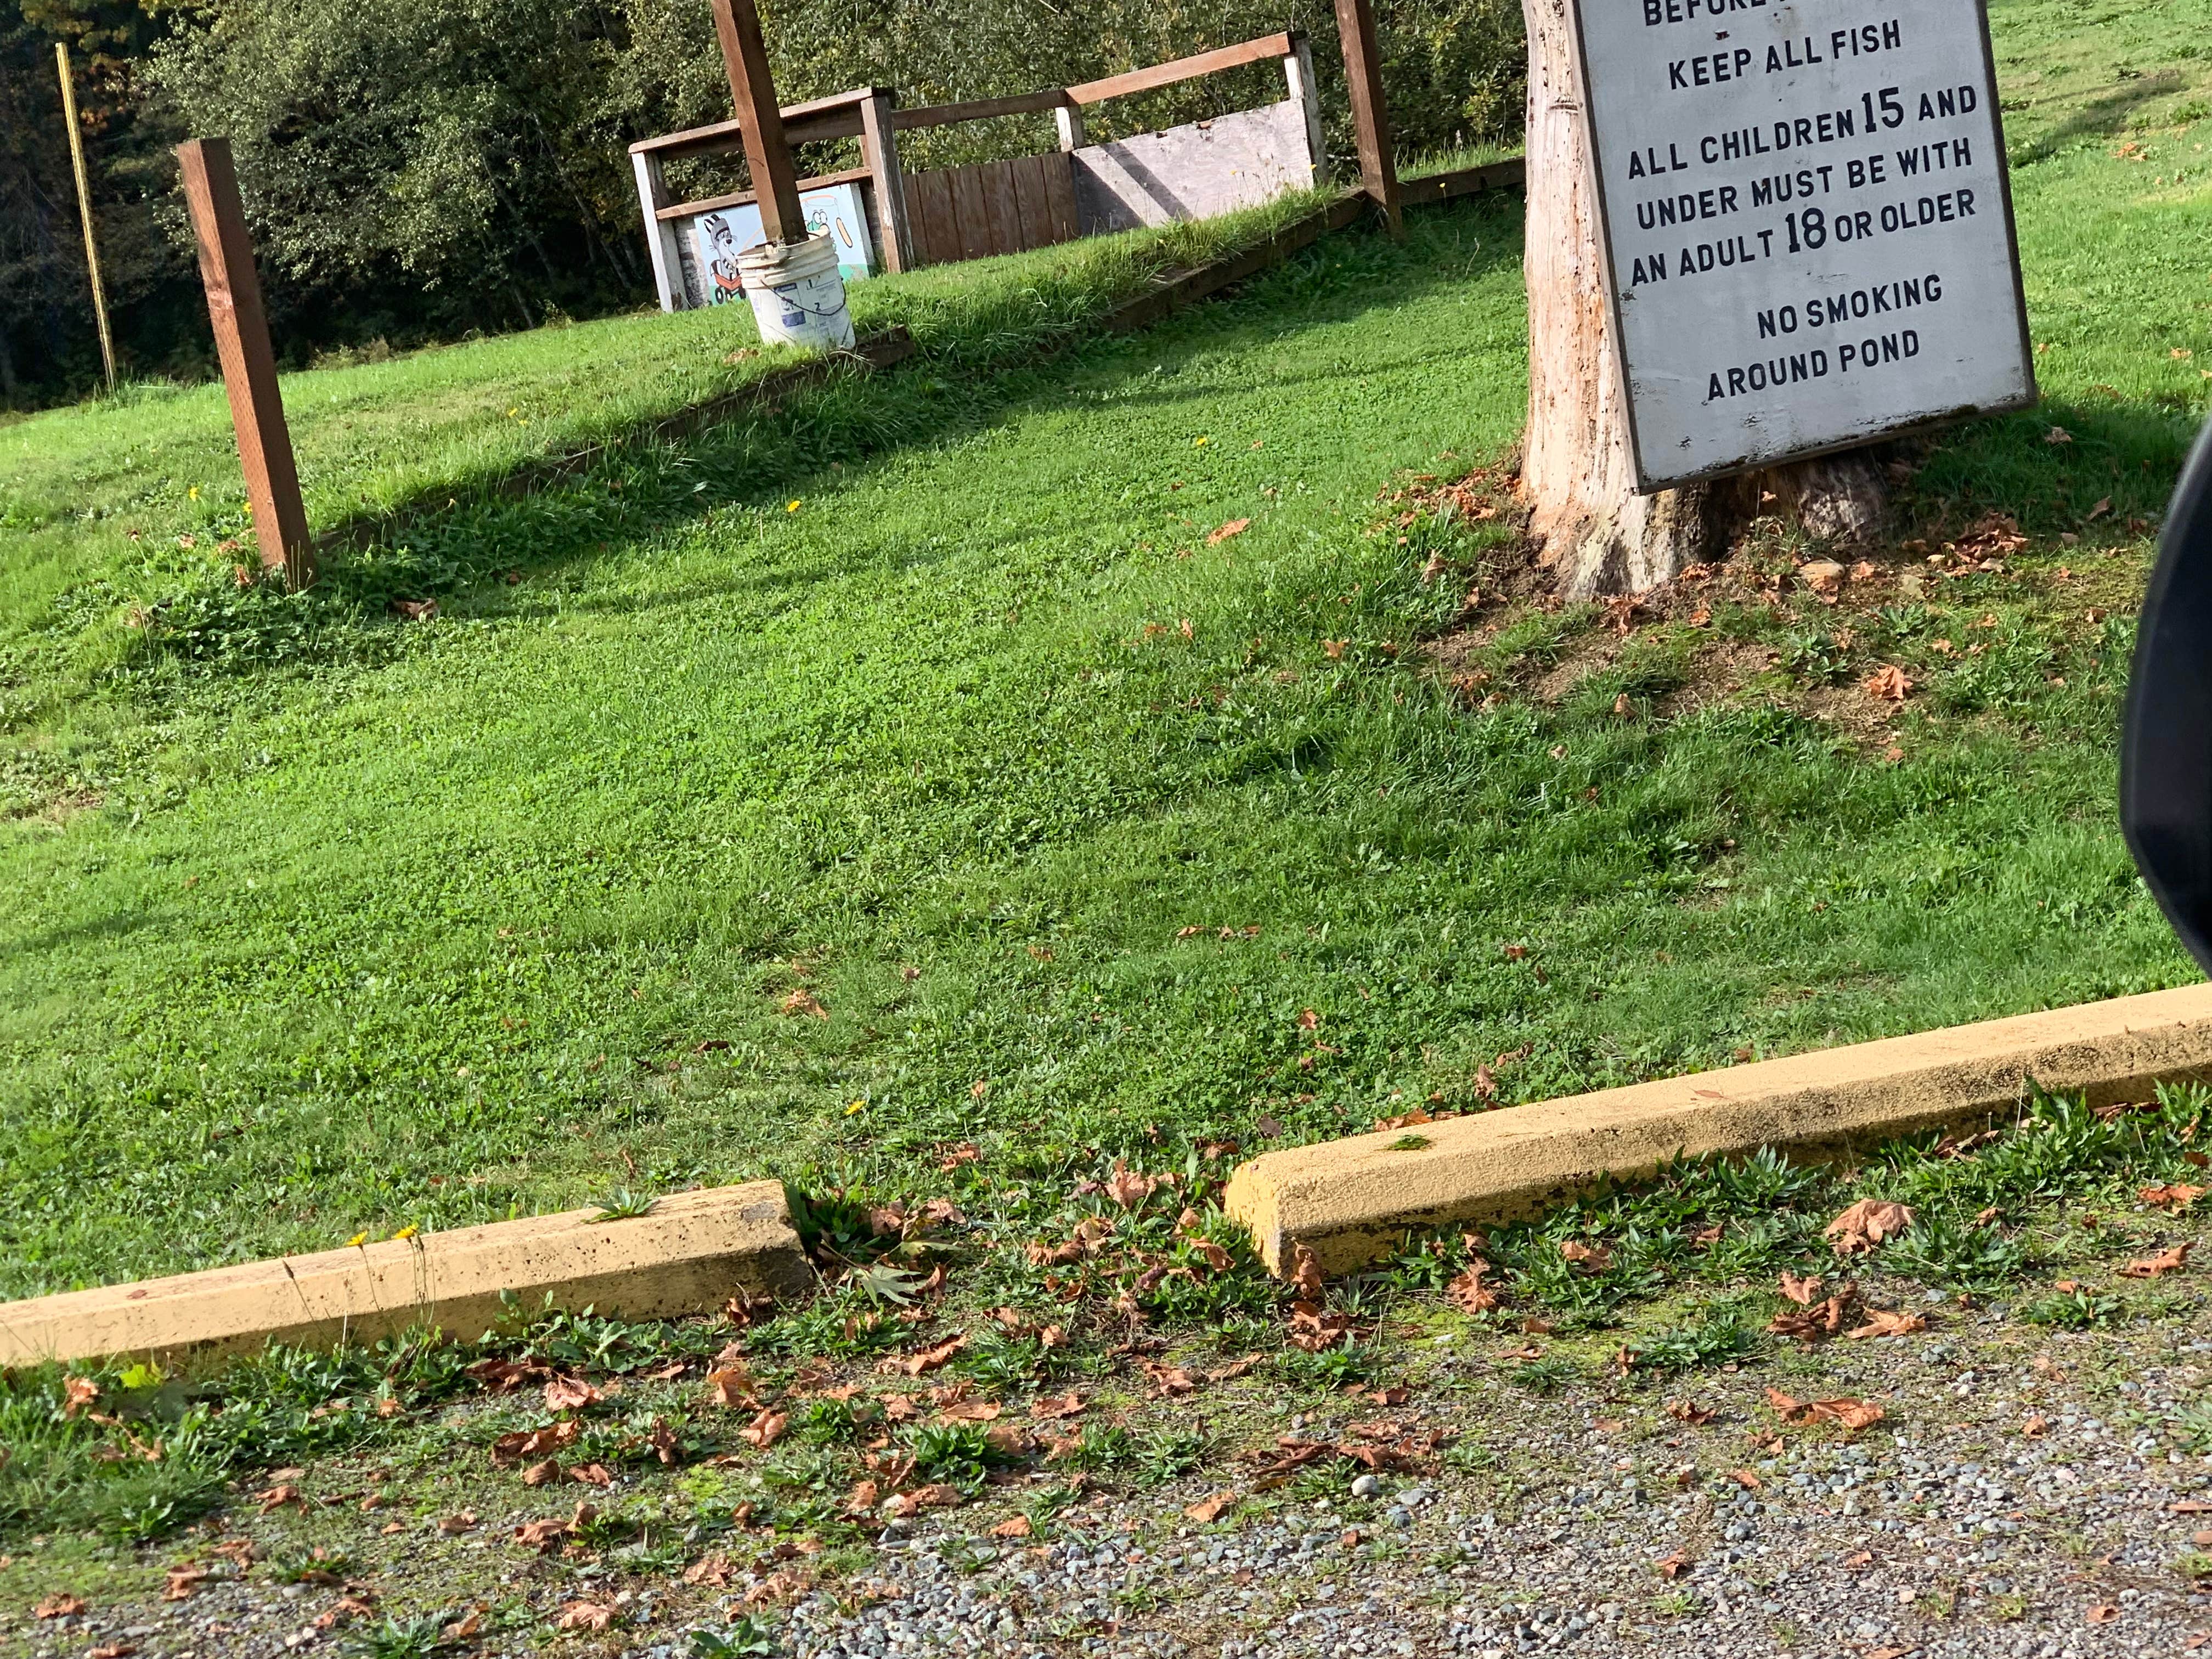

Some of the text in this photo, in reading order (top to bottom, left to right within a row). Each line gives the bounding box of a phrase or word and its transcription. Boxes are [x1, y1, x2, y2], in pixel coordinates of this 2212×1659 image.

[1643, 0, 1767, 26] BEFO
[1668, 19, 1901, 90] KEEP ALL FISH
[1628, 85, 1977, 180] ALL CHILDREN 15 AND
[1637, 137, 1972, 230] UNDER MUST BE WITH
[1632, 189, 1976, 287] AN ADULT 18 OR OLDER
[1757, 274, 1942, 339] NO SMOKING
[1707, 330, 1919, 401] AROUND POND
